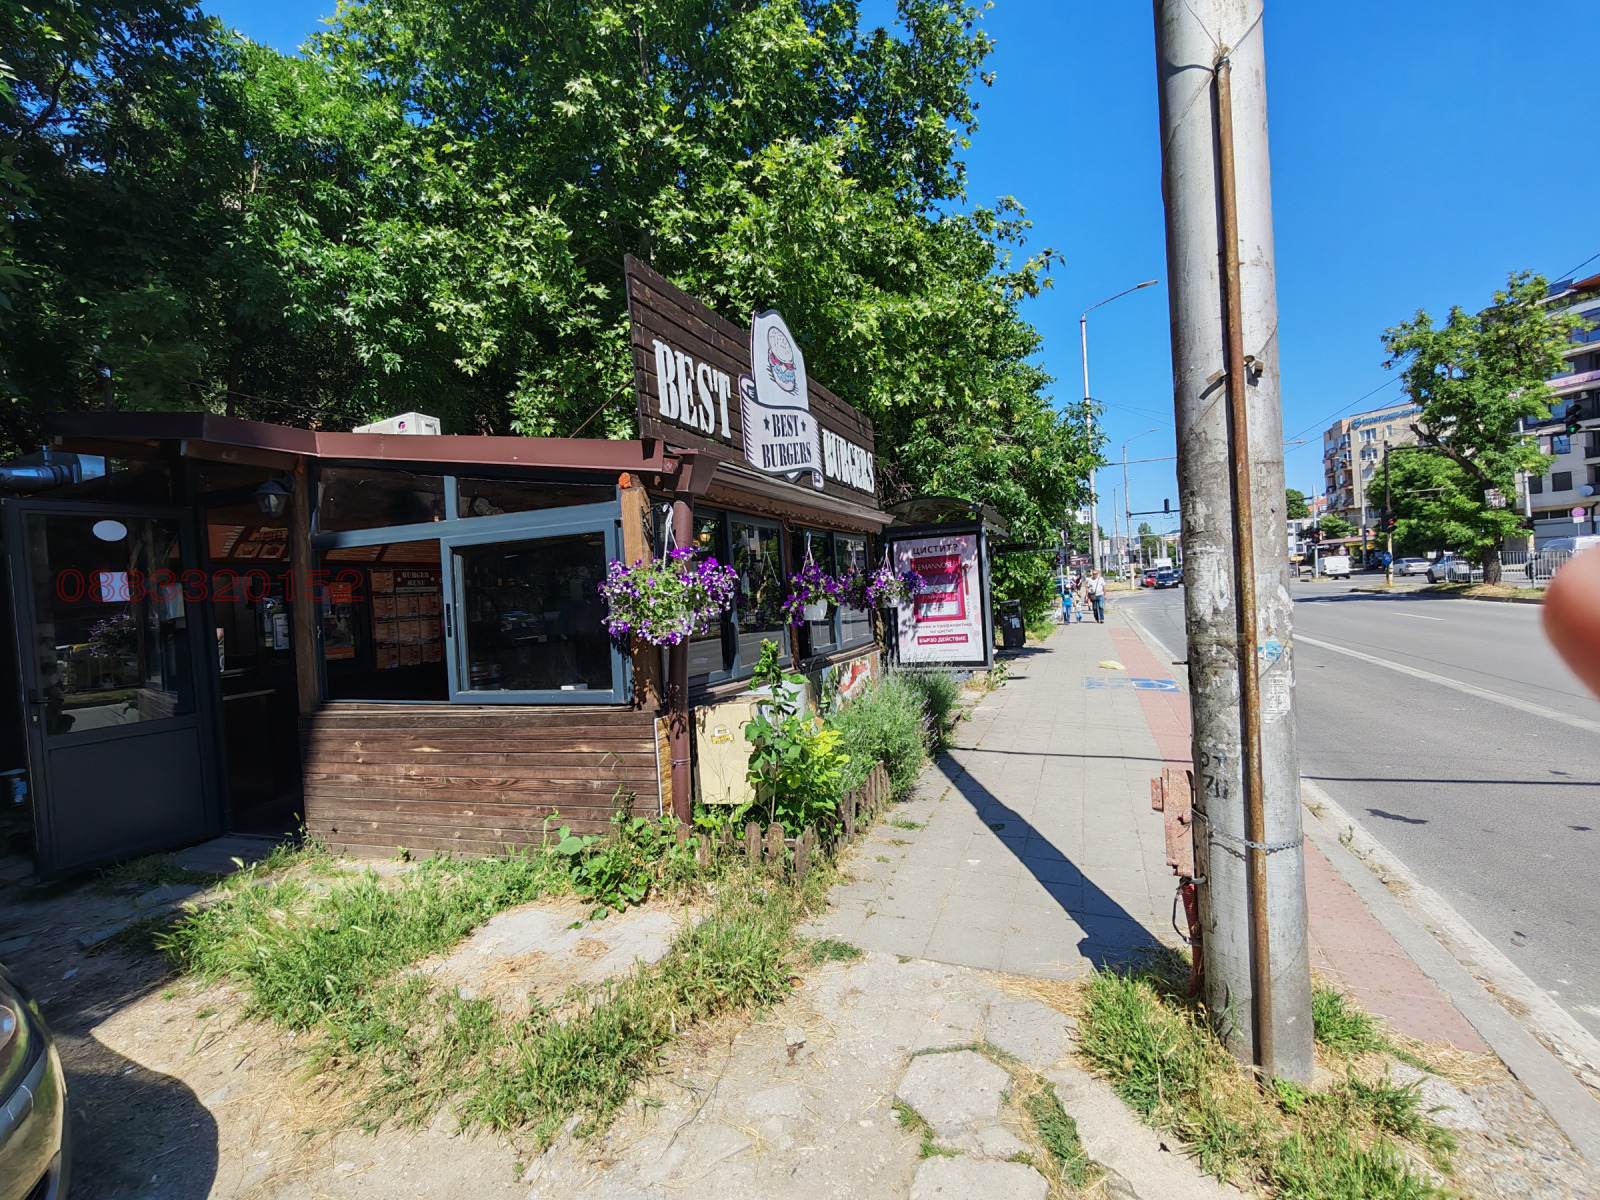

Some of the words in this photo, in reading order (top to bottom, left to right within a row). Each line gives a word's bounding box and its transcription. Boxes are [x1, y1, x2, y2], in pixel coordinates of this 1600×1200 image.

[652, 338, 732, 439] BEST
[772, 413, 800, 438] BEST
[761, 441, 812, 469] BURGERS
[822, 428, 875, 494] BURGERS
[912, 543, 958, 555] ЦИСТИТ?
[401, 571, 430, 579] BURGER
[937, 635, 967, 643] ДЕЙСТВИЕ
